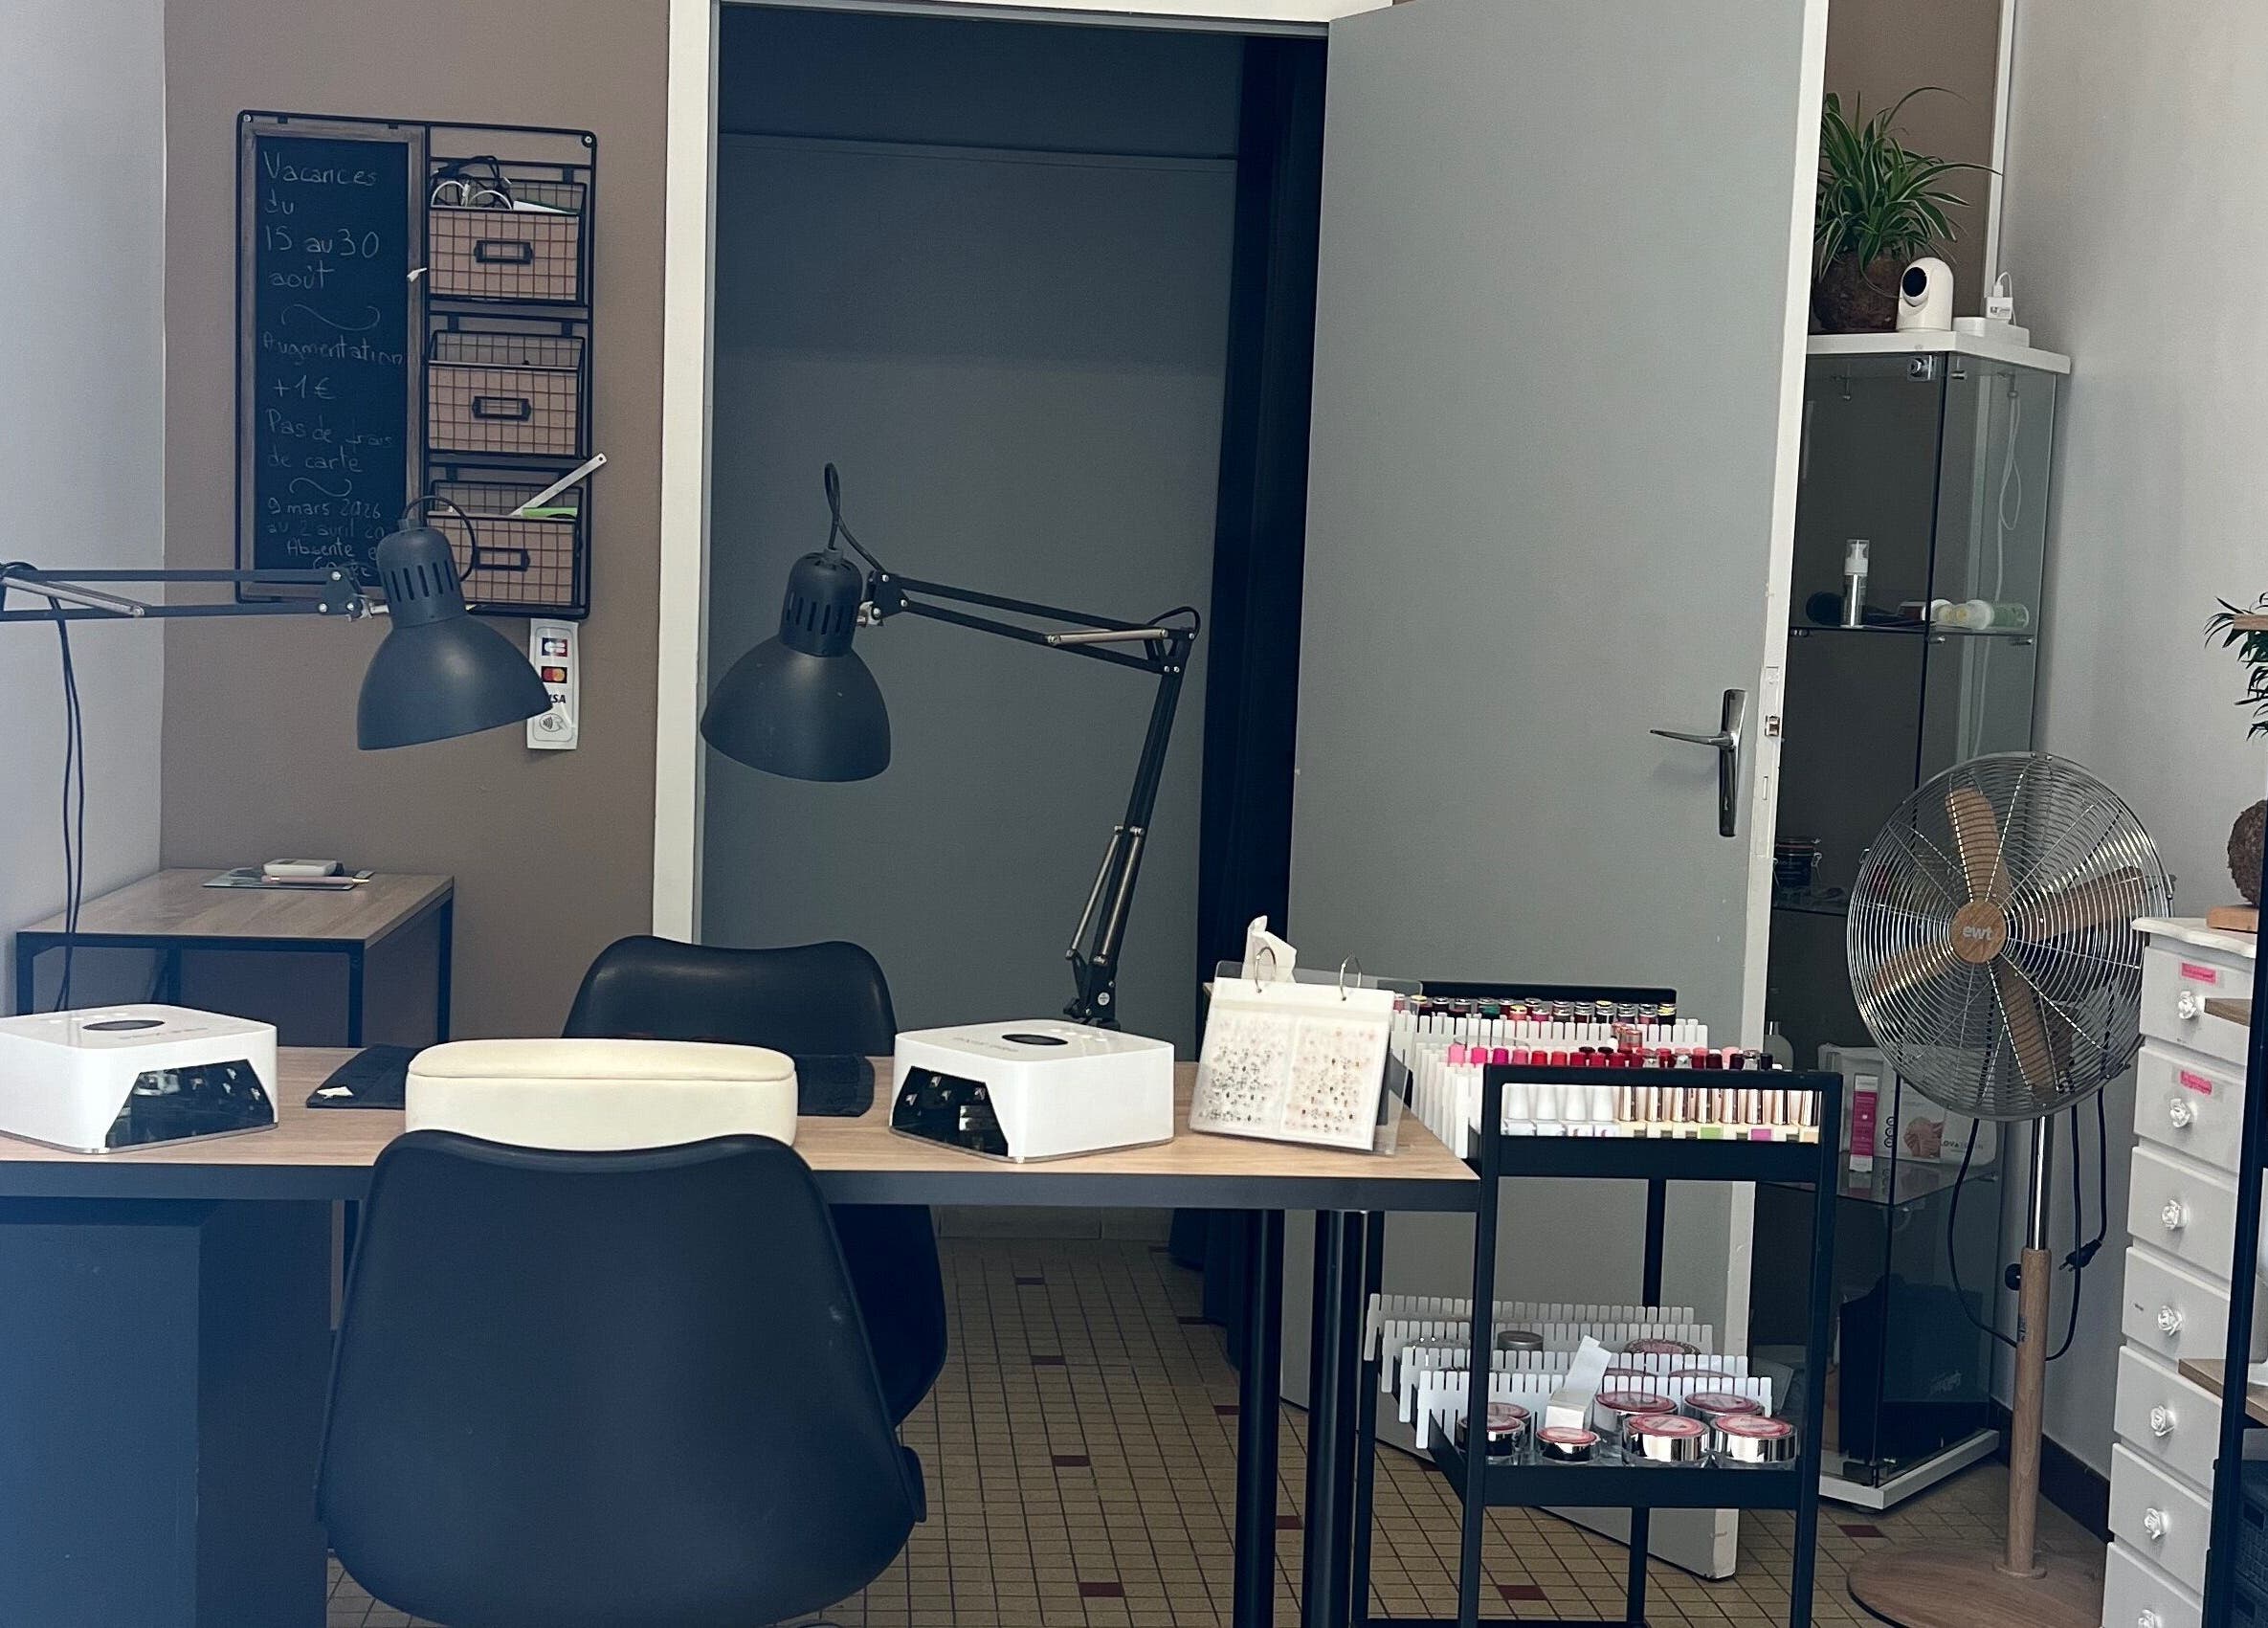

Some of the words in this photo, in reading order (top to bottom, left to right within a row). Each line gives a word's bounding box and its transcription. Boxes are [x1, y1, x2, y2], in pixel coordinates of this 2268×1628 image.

[263, 150, 378, 187] Vacances
[264, 189, 295, 215] du
[265, 225, 293, 252] 15
[304, 235, 333, 255] au
[337, 228, 380, 259] 30
[262, 330, 404, 368] Augmentation
[266, 408, 305, 437] Pas
[312, 414, 333, 444] de
[267, 441, 292, 469] de
[304, 445, 364, 473] carte
[286, 502, 330, 516] mars
[339, 498, 383, 520] 2026
[267, 520, 289, 534] au
[317, 518, 354, 538] avril
[286, 536, 355, 557] Absente
[1962, 926, 1993, 942] ewt
